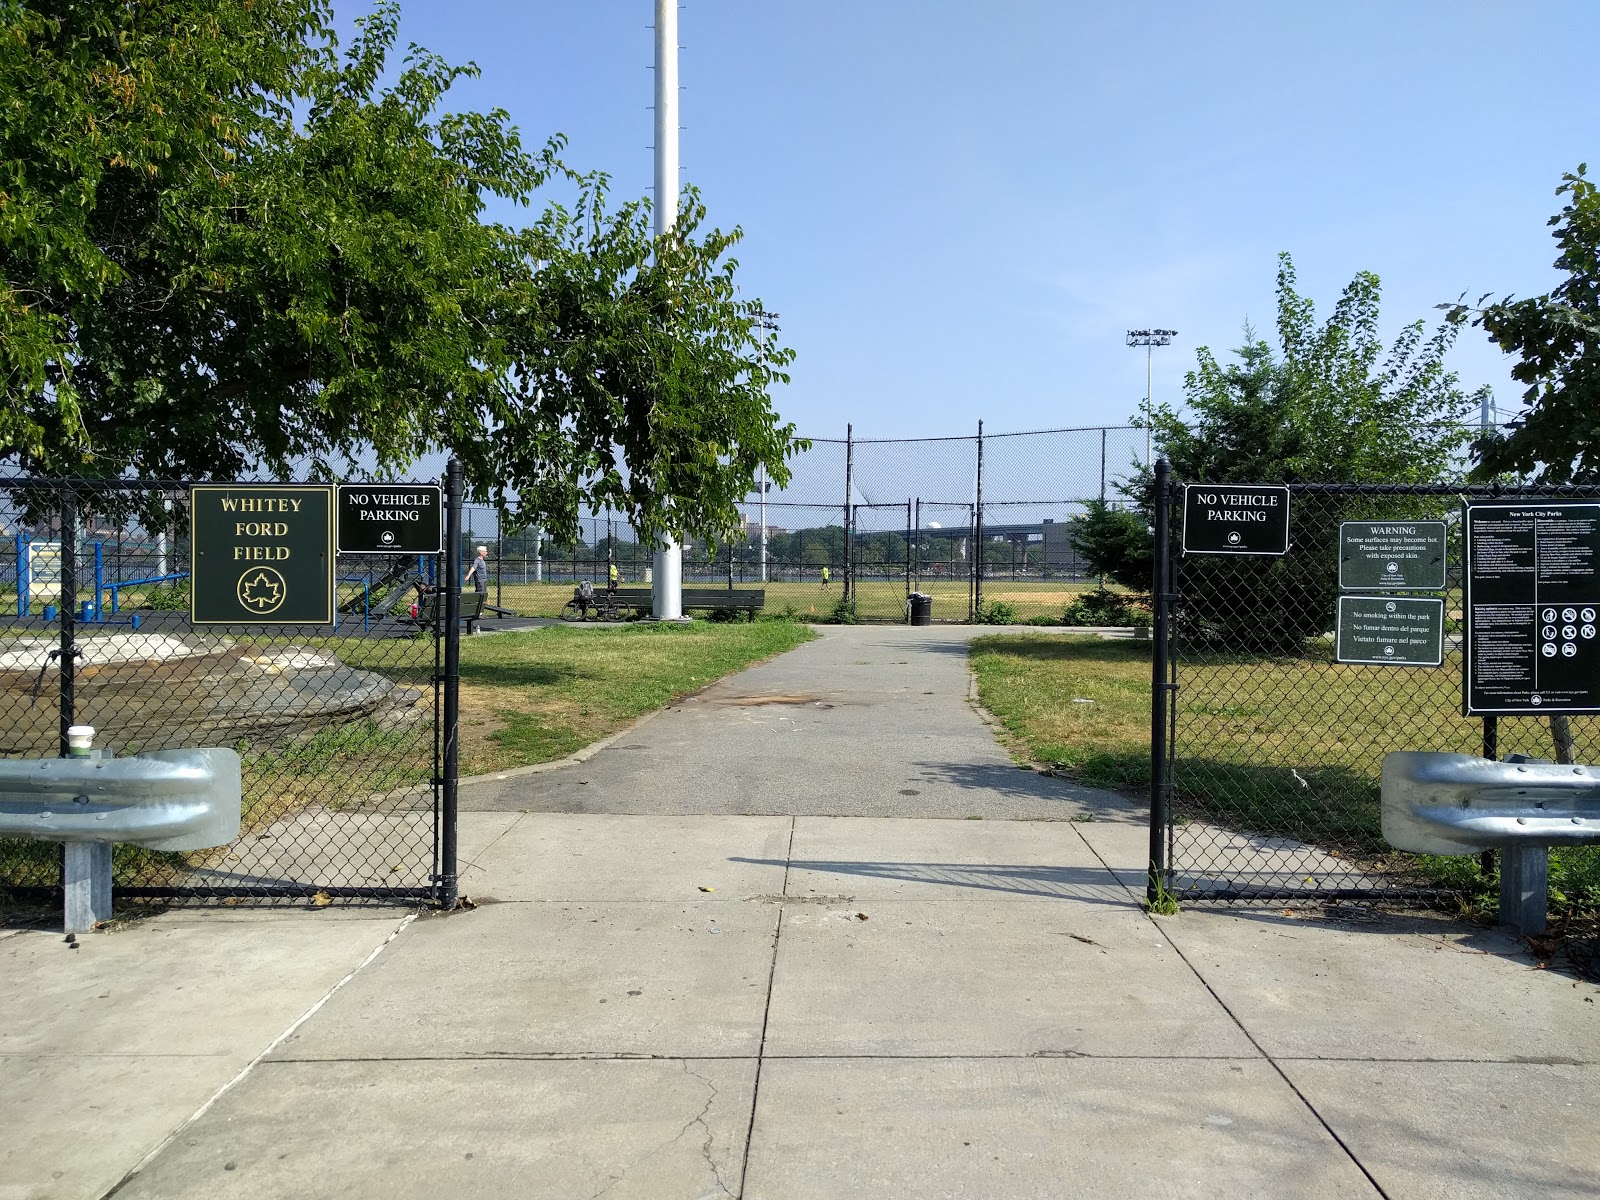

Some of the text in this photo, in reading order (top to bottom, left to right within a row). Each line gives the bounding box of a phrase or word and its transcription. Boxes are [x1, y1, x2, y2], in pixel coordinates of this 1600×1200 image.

[221, 498, 303, 512] WHITEY
[349, 494, 431, 506] NO VEHICLE
[1197, 493, 1278, 506] NO VEHICLE
[360, 509, 420, 521] PARKING
[1207, 510, 1266, 522] PARKING
[235, 522, 289, 536] FORD
[1370, 527, 1416, 535] WARNING
[233, 546, 291, 560] FIELD
[1392, 544, 1427, 552] precautions
[1380, 552, 1405, 561] exposed
[1363, 612, 1388, 620] smoking
[1410, 626, 1430, 634] parque
